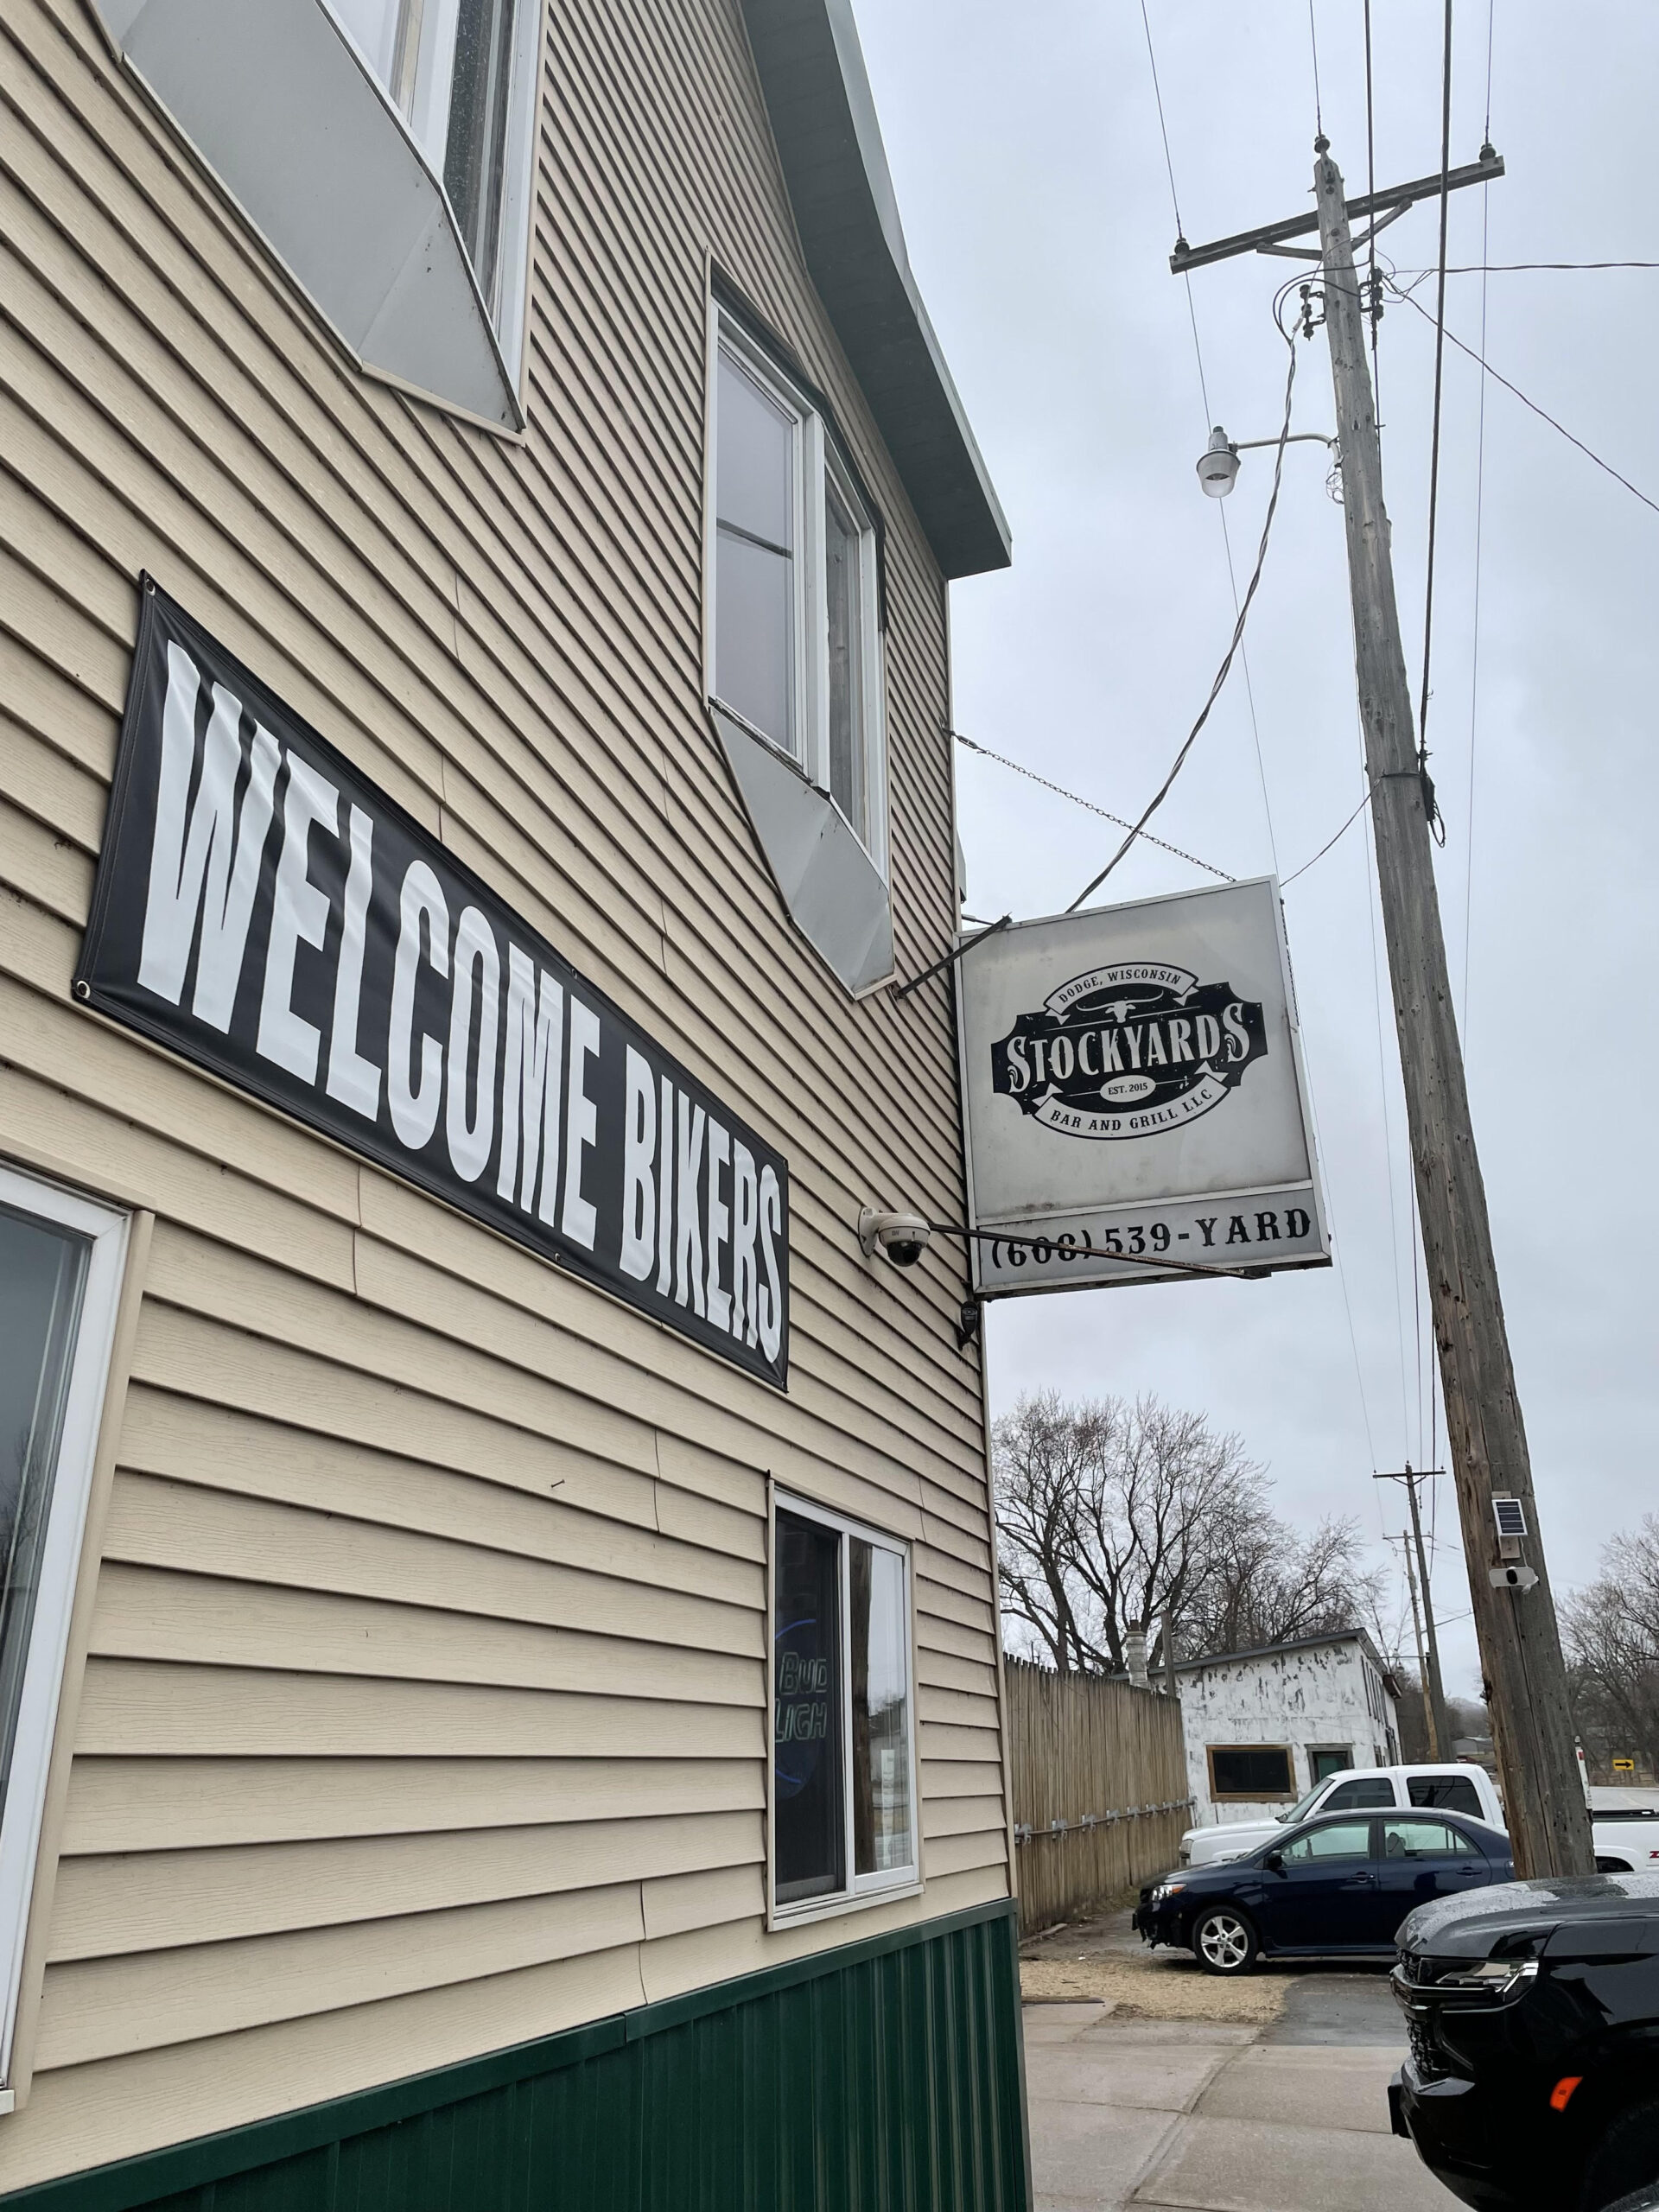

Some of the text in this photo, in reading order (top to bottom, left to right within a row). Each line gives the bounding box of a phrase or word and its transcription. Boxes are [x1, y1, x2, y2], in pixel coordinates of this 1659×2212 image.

[137, 639, 783, 1363] WELCOME BIKERS
[1058, 969, 1182, 1004] DODGE, WISCONSIN
[1007, 1002, 1250, 1094] STOCKYARDS
[1050, 1089, 1213, 1131] BAR AND GRILL LLC
[1108, 1082, 1148, 1096] EST. 2015
